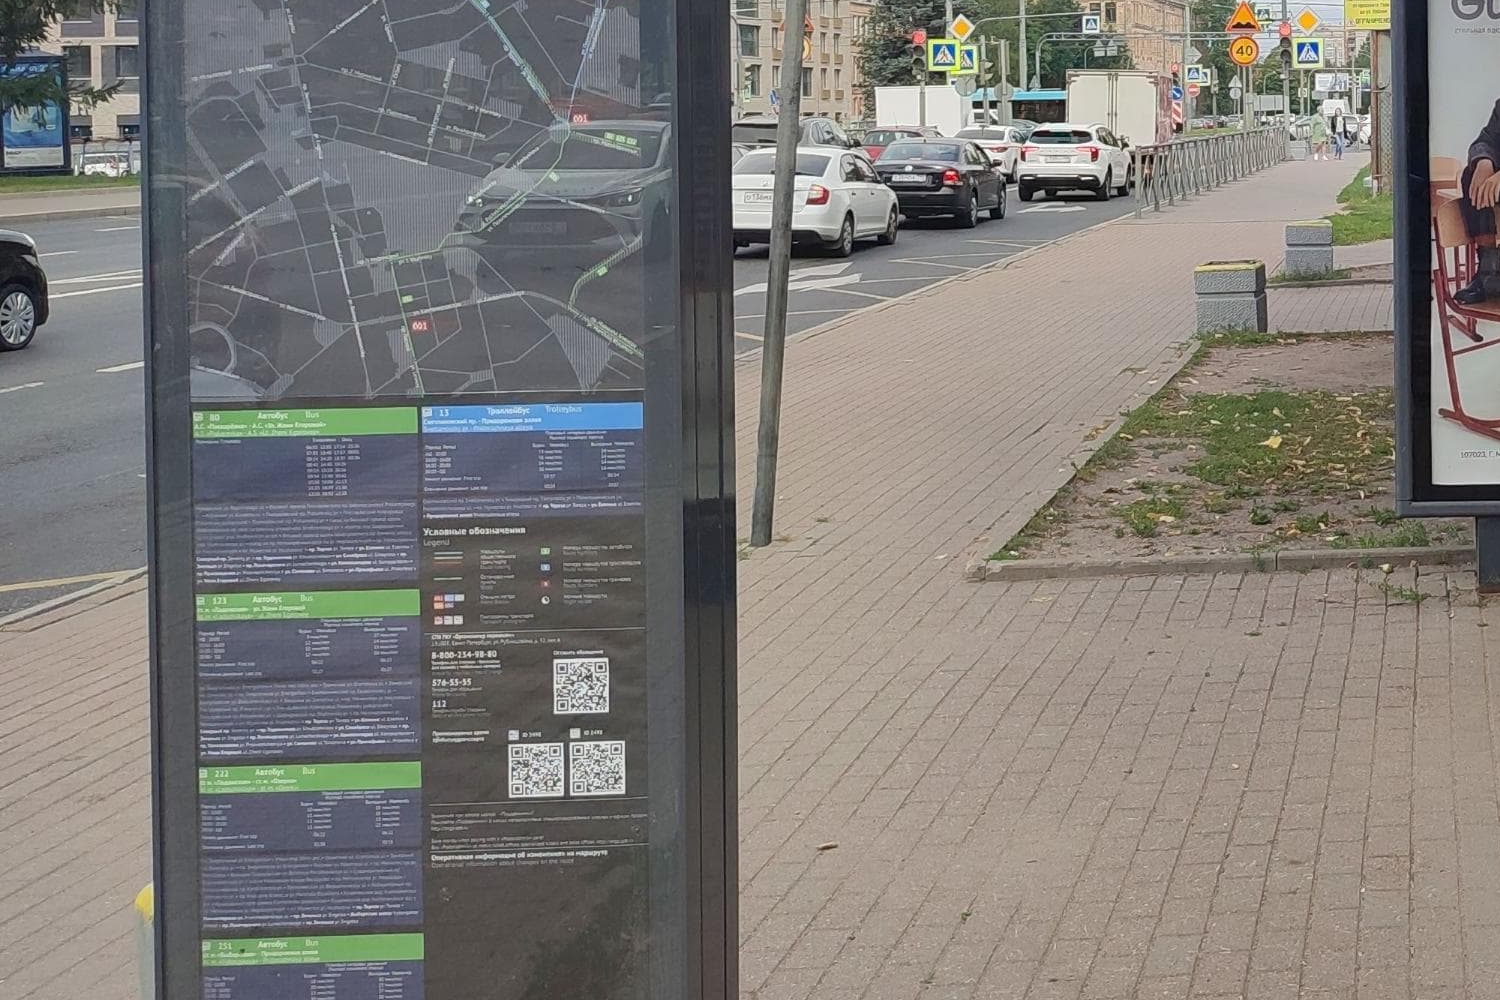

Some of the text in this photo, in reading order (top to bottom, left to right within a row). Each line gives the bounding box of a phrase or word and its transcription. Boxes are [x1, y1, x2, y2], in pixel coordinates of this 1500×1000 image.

[1235, 45, 1254, 57] 40
[423, 526, 526, 537] Условные обозначения
[213, 597, 227, 605] 123
[431, 699, 447, 708] 112
[214, 770, 229, 778] 222
